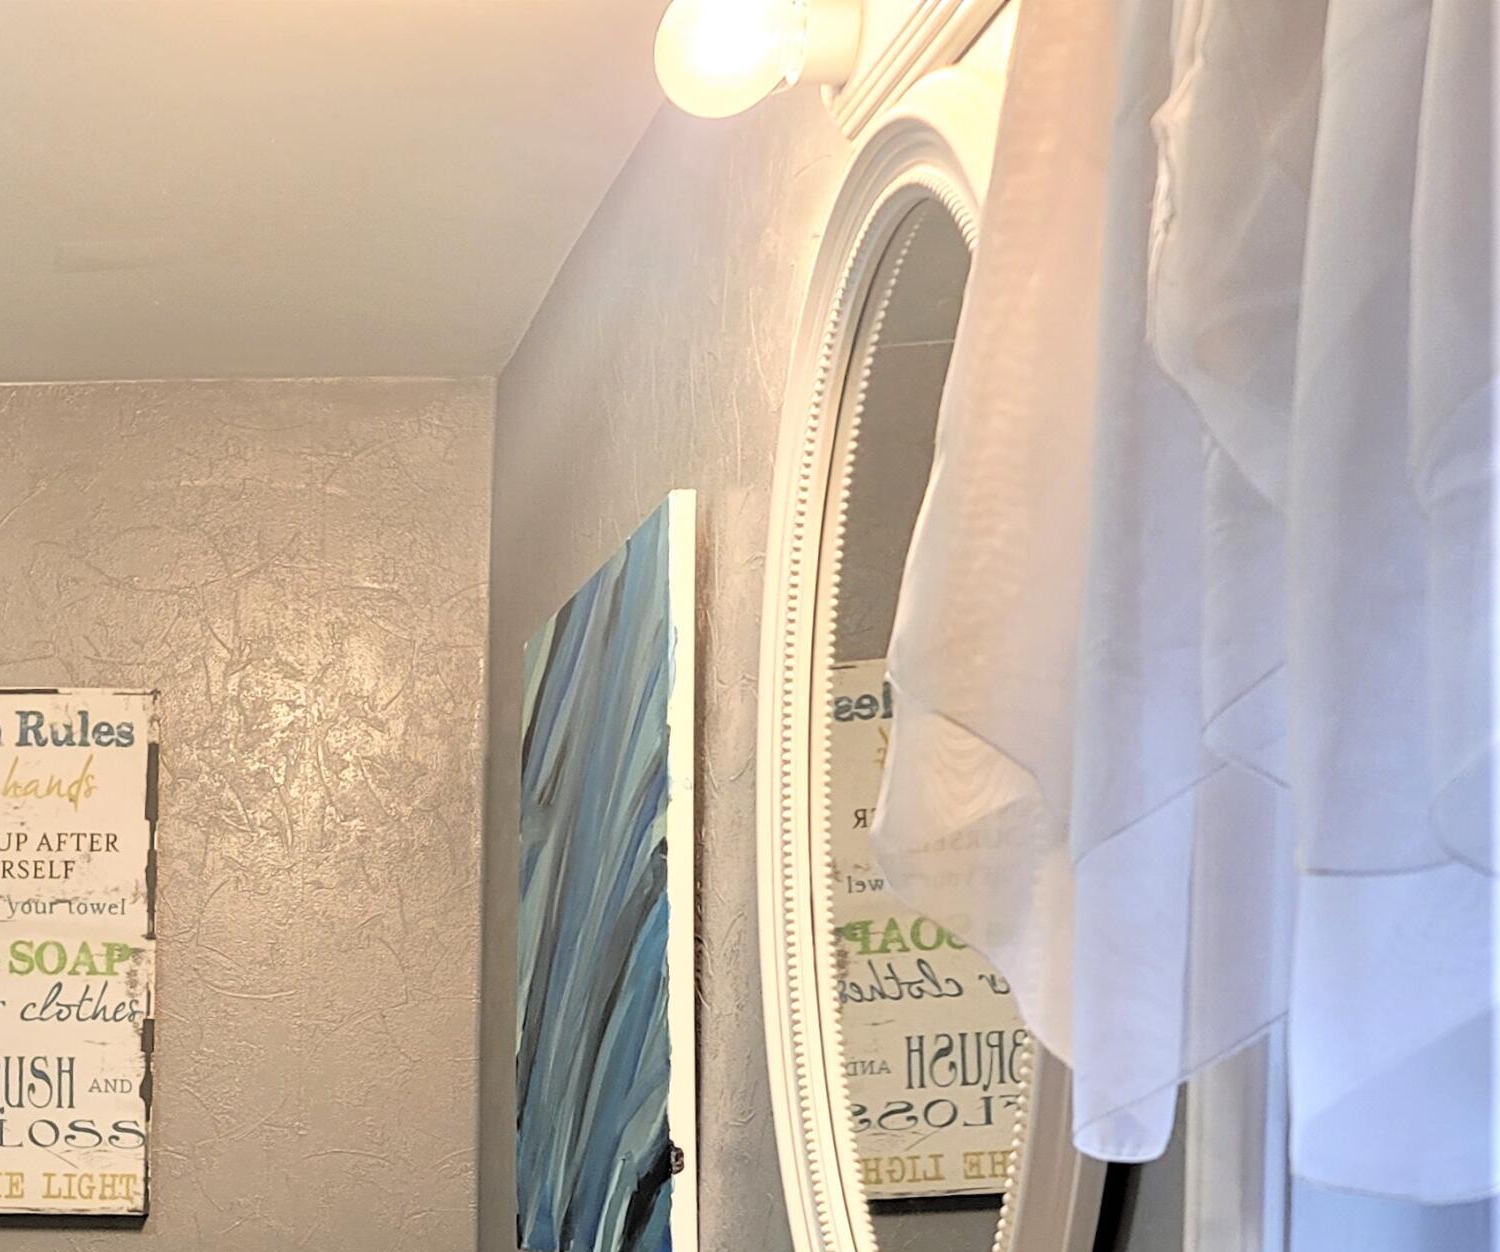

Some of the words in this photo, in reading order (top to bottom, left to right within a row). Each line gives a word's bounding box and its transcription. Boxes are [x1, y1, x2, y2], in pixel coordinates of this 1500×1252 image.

[15, 710, 134, 747] Rules
[1, 755, 97, 812] hands
[36, 833, 120, 853] AFTER
[7, 900, 56, 919] your
[66, 897, 126, 915] towel
[8, 941, 135, 977] SOAP
[20, 981, 144, 1023] clothes
[88, 1079, 133, 1094] AND
[42, 1173, 138, 1200] LIGHT
